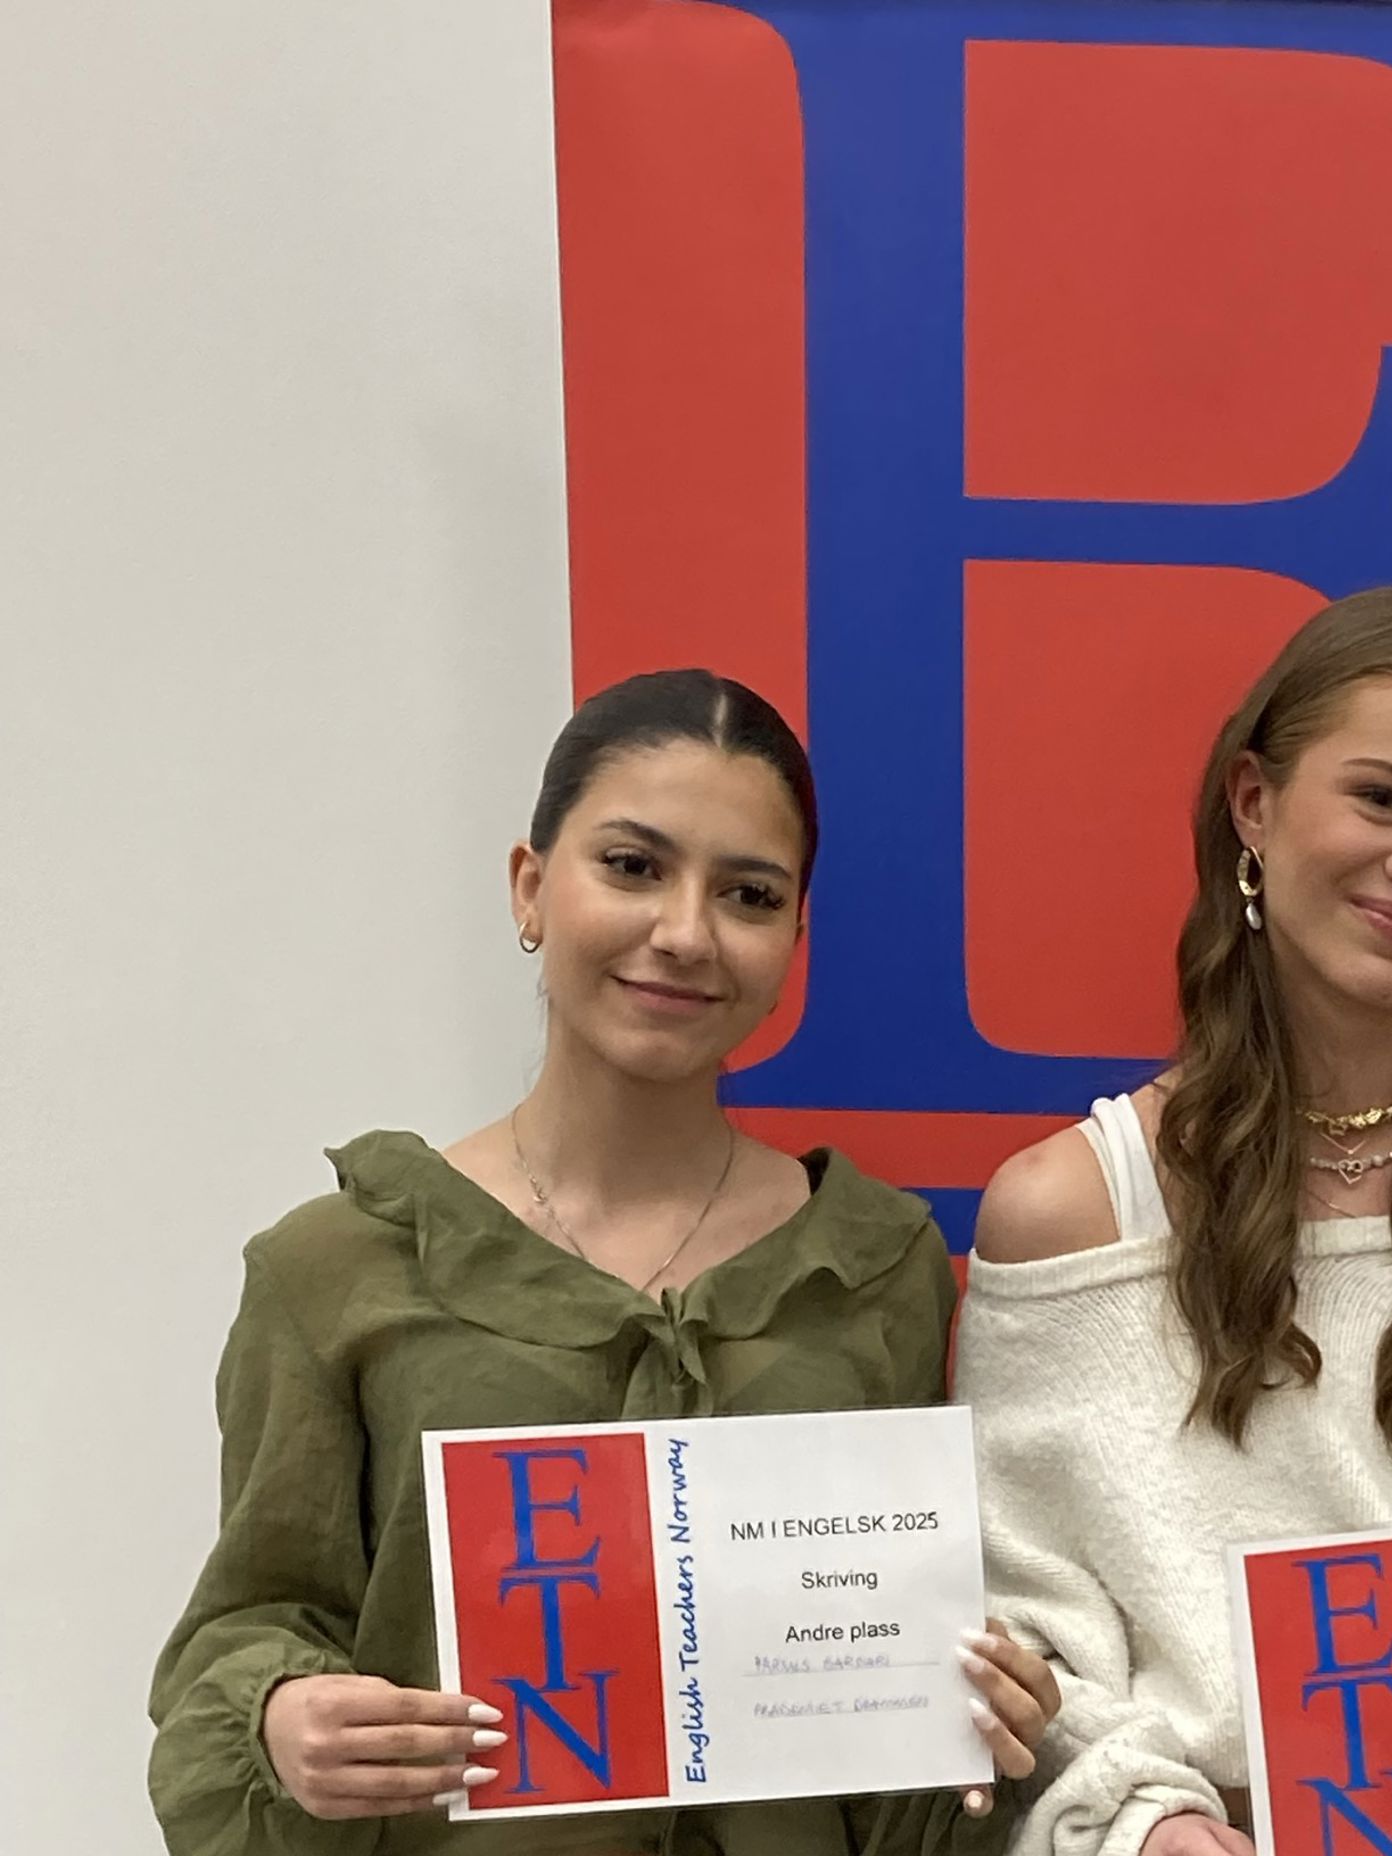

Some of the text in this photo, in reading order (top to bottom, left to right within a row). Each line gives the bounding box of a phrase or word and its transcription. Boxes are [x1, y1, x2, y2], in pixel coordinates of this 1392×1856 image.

[730, 1511, 939, 1541] NM I ENGELSK 2025
[801, 1571, 878, 1591] Skriving
[668, 1439, 710, 1783] English Teachers Norway
[785, 1621, 900, 1644] Andre plass
